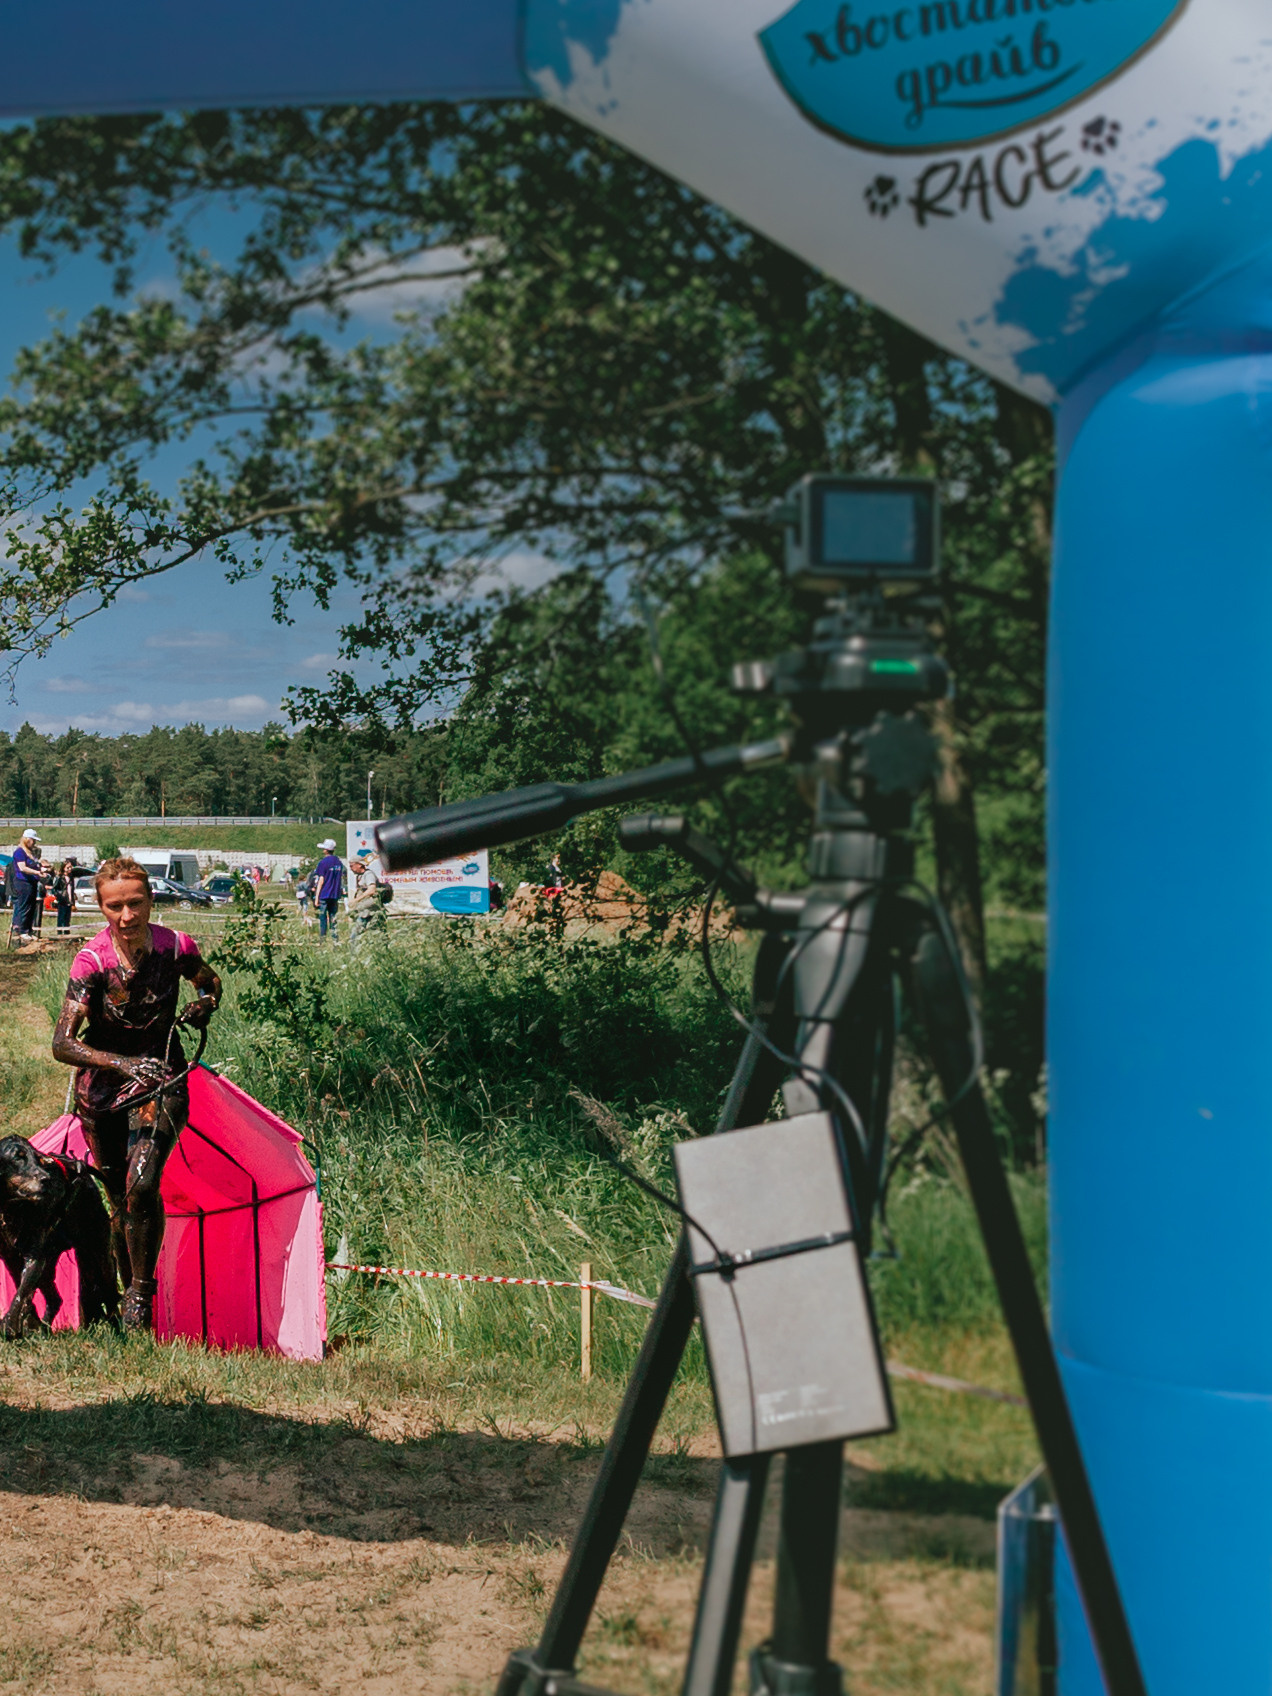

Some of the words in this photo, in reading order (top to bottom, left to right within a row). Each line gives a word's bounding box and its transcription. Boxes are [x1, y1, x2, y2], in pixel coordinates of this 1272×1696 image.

[805, 0, 1108, 67] хвоста
[895, 20, 1061, 131] драйв
[906, 125, 1083, 228] RACE
